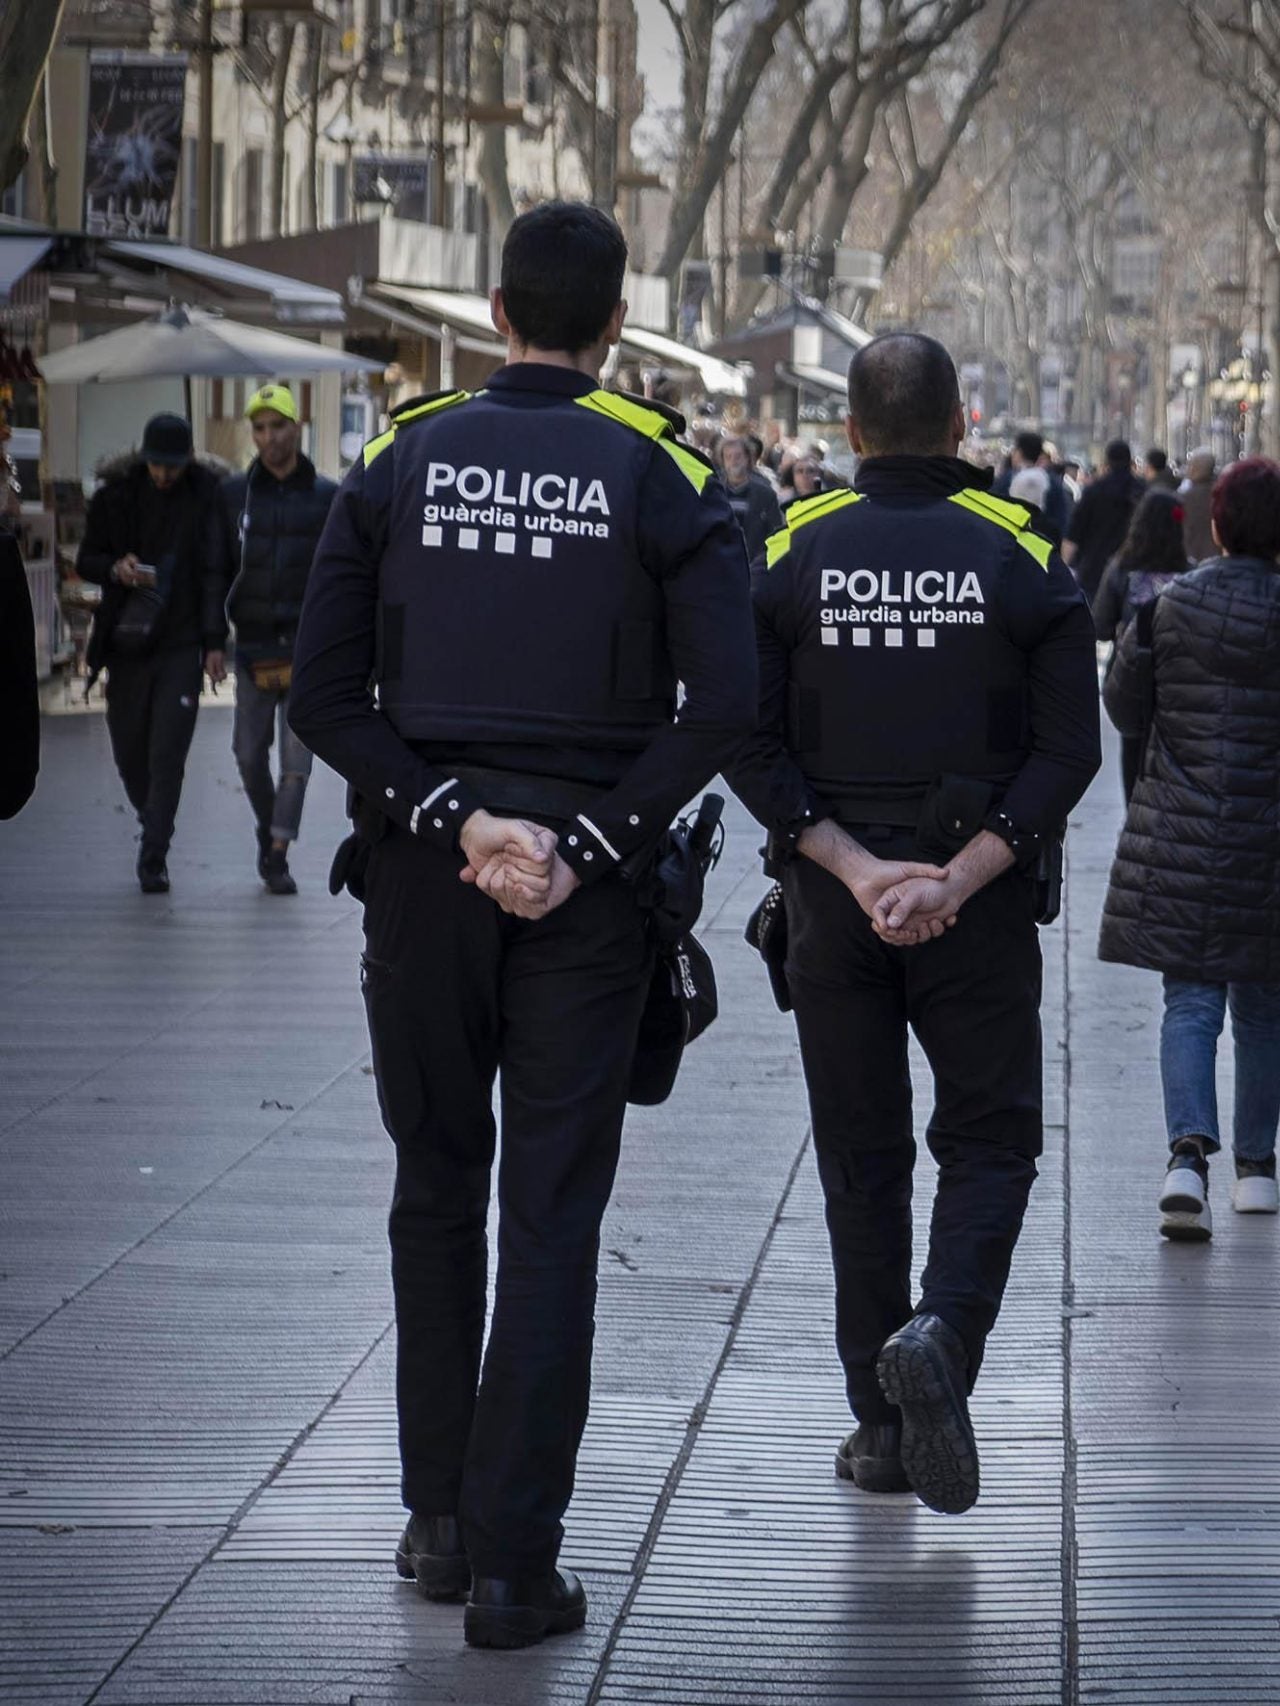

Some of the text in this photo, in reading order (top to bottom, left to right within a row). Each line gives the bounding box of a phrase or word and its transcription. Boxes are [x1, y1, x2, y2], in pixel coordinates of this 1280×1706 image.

[86, 192, 169, 228] LLUM
[425, 461, 611, 516] POLICIA
[423, 503, 609, 539] guàrdia urbana
[820, 568, 985, 604] POLICIA
[820, 605, 985, 625] guàrdia urbana
